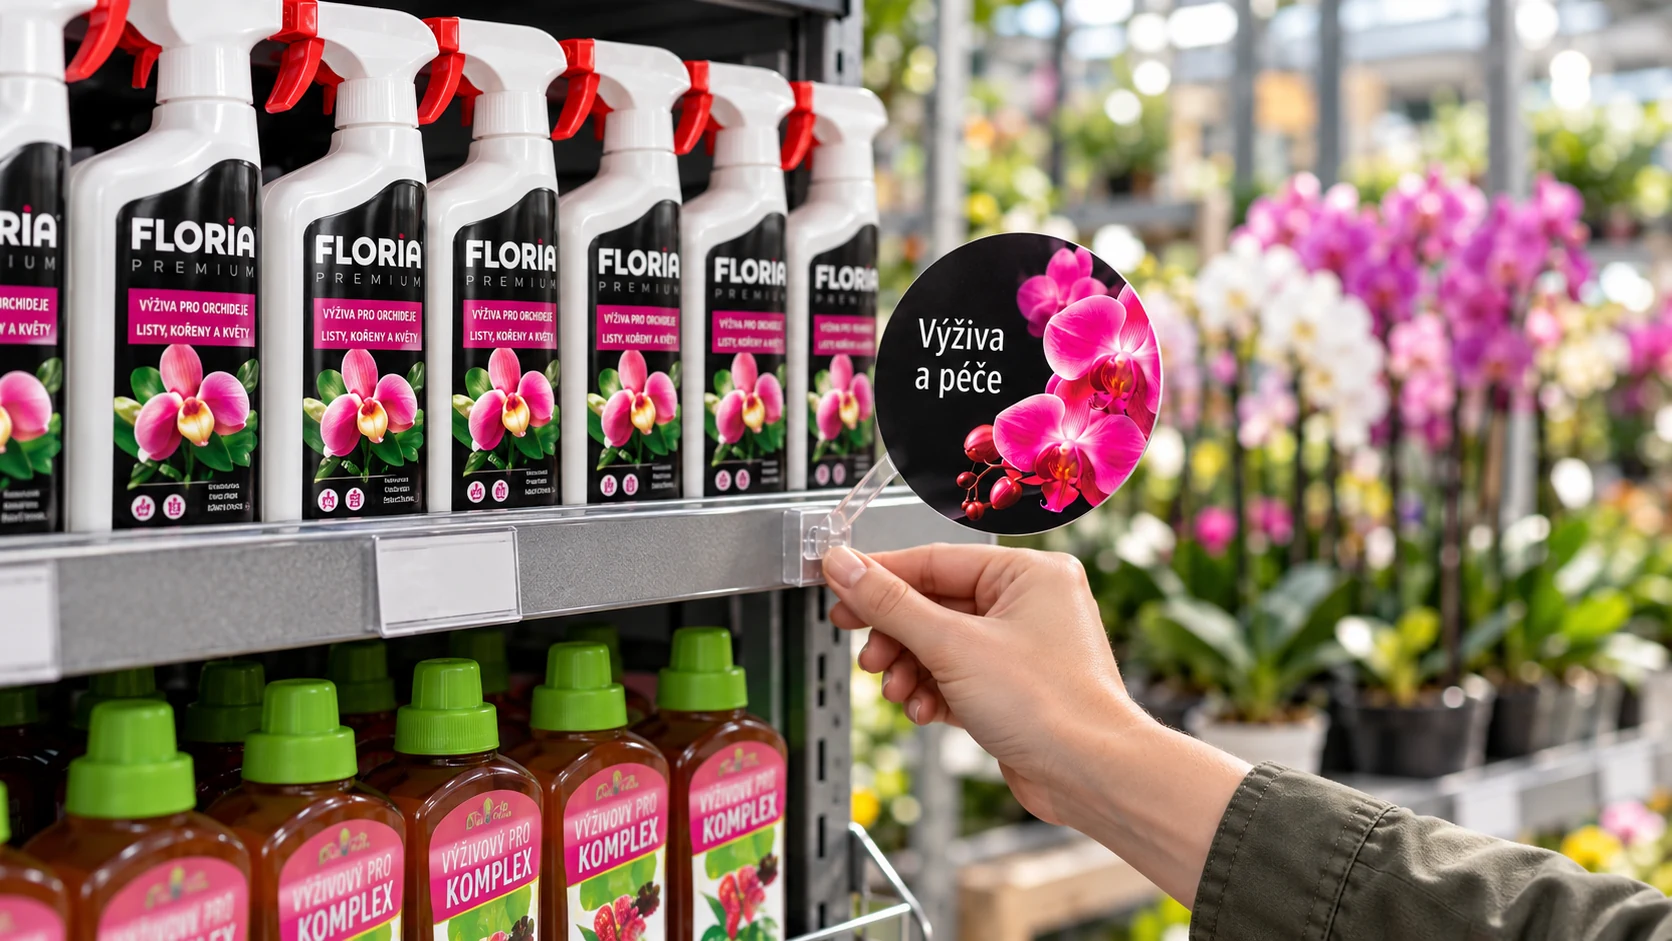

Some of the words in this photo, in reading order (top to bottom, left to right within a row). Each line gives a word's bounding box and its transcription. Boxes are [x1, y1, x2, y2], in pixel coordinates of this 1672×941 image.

[131, 216, 255, 258] FLORIA
[315, 233, 422, 269] FLORIA
[131, 259, 255, 278] PREMIUM
[465, 238, 557, 272] FLORIA
[598, 247, 680, 279] FLORIA
[315, 272, 421, 287] PREMIUM
[466, 275, 556, 290] PREMIUM
[714, 257, 786, 287] FLORIA
[815, 264, 879, 292] FLORIA
[139, 297, 177, 312] VÝŽIVA
[180, 300, 200, 313] PRO
[202, 302, 248, 316] ORCHIDEJE
[322, 306, 356, 320] VÝŽIVA
[357, 309, 375, 320] PRO
[376, 310, 416, 322] ORCHIDEJE
[472, 306, 502, 320] VÝŽIVA
[503, 310, 518, 321] PRO
[603, 312, 630, 325] VÝŽIVA
[631, 314, 645, 325] PRO
[8, 322, 16, 335] A
[136, 323, 168, 338] LISTY,
[170, 322, 211, 337] KOŘENY
[213, 326, 220, 337] A
[321, 330, 348, 344] LISTY,
[350, 328, 386, 342] KOŘENY
[387, 332, 393, 342] A
[469, 330, 495, 343] LISTY,
[496, 328, 527, 341] KOŘENY
[528, 332, 534, 341] A
[602, 333, 625, 344] LISTY,
[918, 317, 1004, 356] Výživa
[915, 367, 929, 389] a
[939, 361, 1002, 398] péče
[575, 799, 632, 840] VÝŽIVOVÝ
[635, 792, 657, 819] PRO
[702, 791, 778, 844] KOMPLEX
[442, 829, 505, 874] VÝŽIVOVÝ
[509, 821, 530, 850] PRO
[578, 816, 659, 873] KOMPLEX
[367, 853, 392, 885] PRO
[446, 847, 532, 909] KOMPLEX
[297, 879, 394, 941] KOMPLEX
